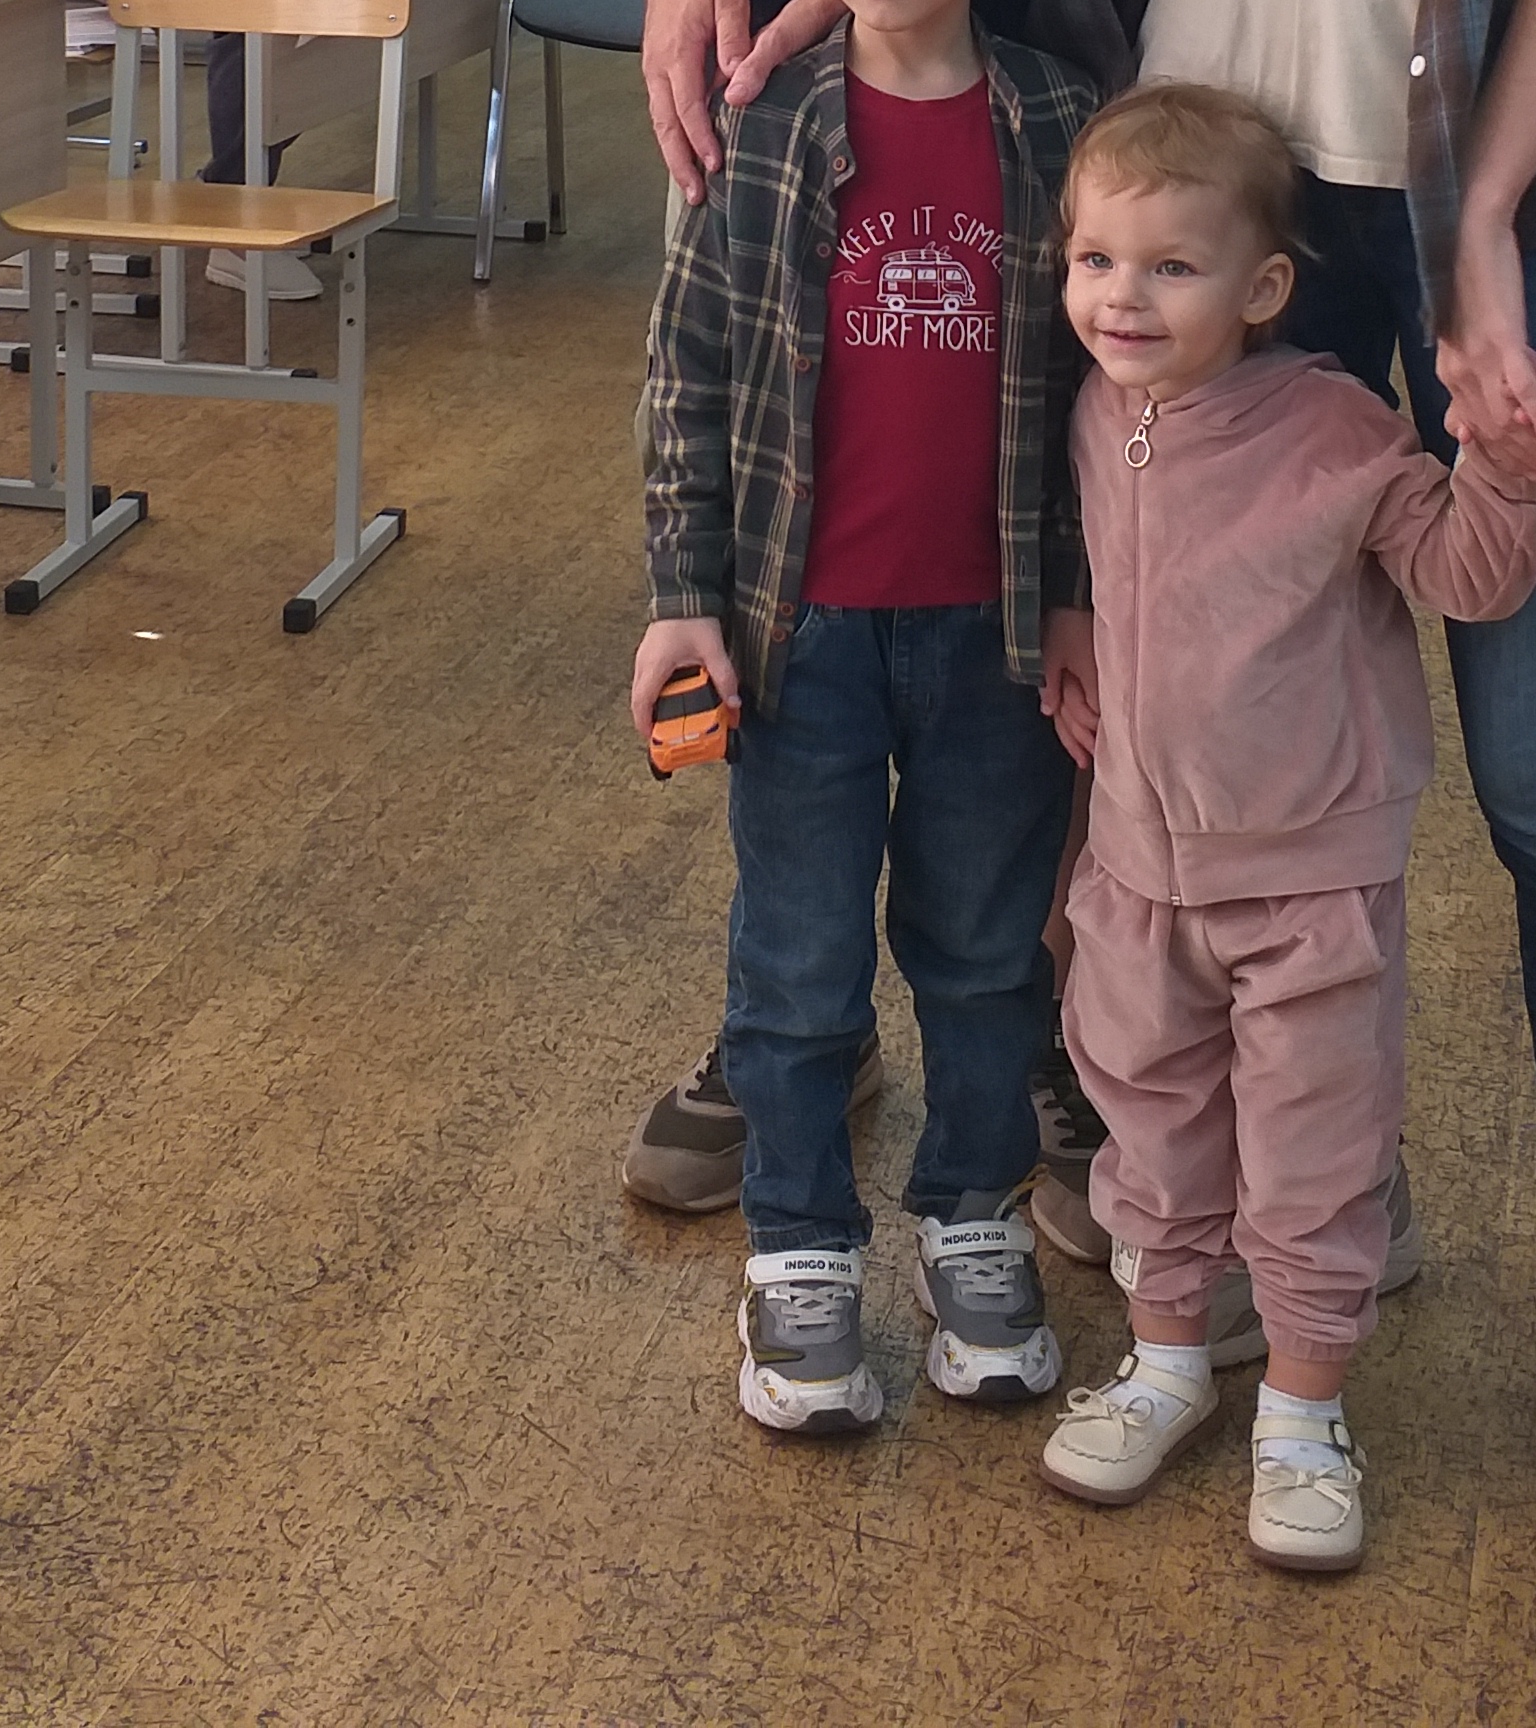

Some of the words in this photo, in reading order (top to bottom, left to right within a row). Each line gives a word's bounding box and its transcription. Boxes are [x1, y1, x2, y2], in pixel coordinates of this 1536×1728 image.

[837, 211, 896, 264] KEEP
[913, 206, 935, 236] IT
[948, 212, 1004, 277] SIMPL
[845, 310, 913, 348] SURF
[924, 314, 996, 352] MORE
[941, 1232, 982, 1246] INDIGO
[983, 1230, 1007, 1242] KIDS
[785, 1259, 826, 1270] INDIGO
[829, 1260, 852, 1273] KIDS
